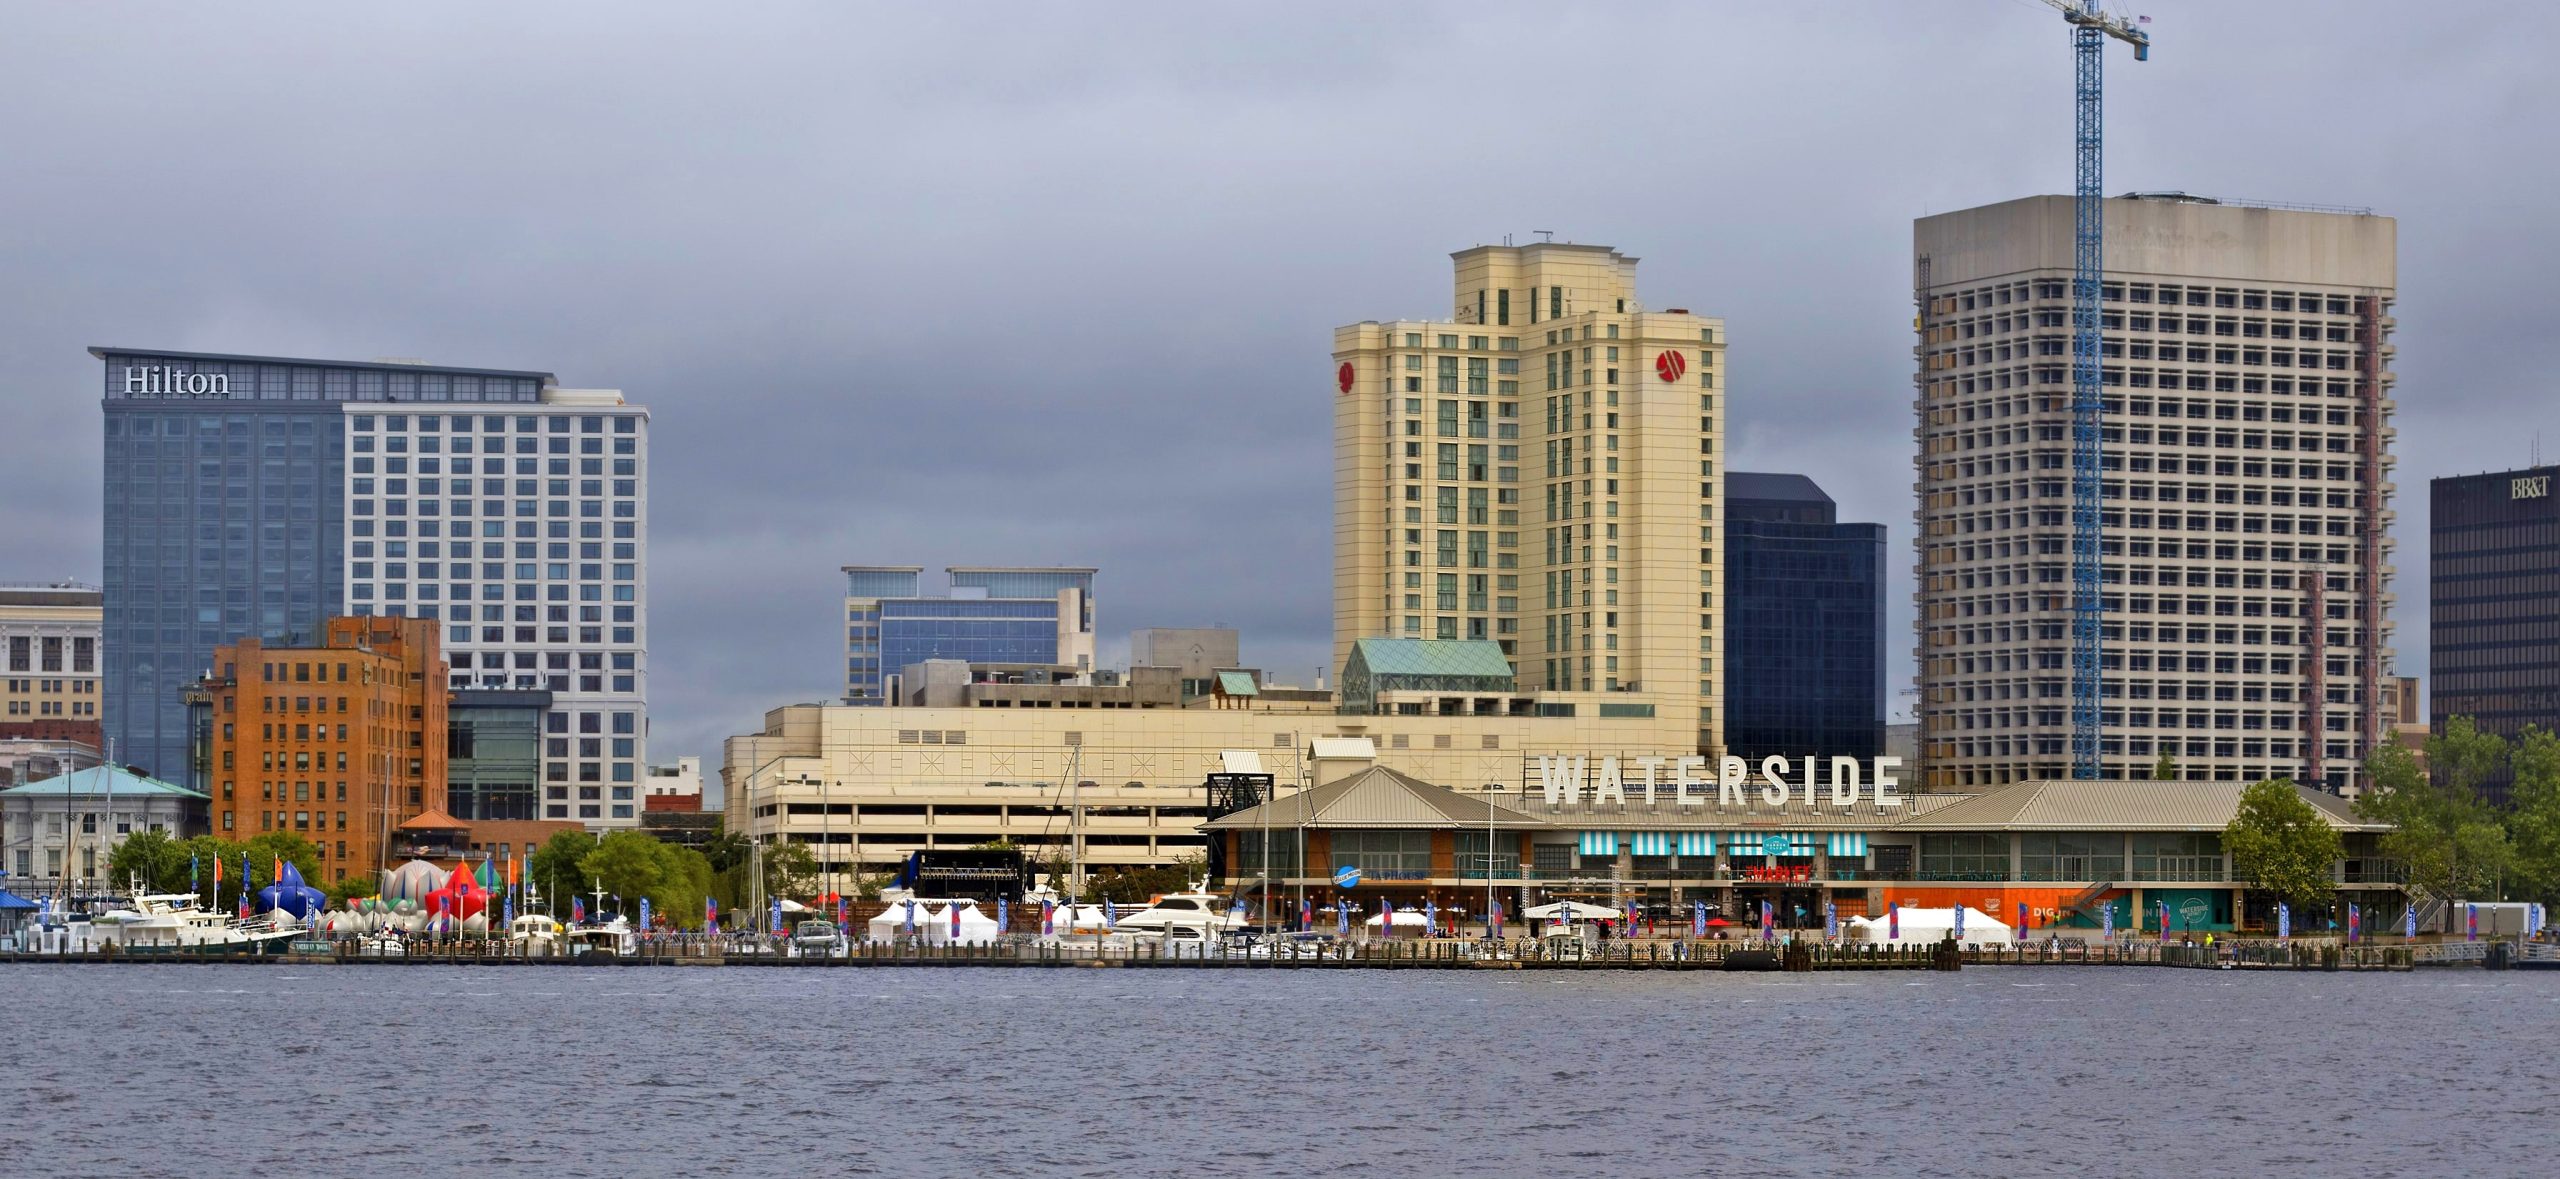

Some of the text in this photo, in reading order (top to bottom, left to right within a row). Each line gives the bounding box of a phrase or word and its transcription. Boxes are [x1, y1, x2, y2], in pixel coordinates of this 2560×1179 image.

[124, 365, 230, 394] Hilton
[2511, 475, 2551, 499] BB&T
[185, 689, 213, 706] grain
[1539, 754, 1902, 806] WATERSIDE
[1753, 865, 1811, 883] MARKET
[2033, 907, 2054, 917] DIG
